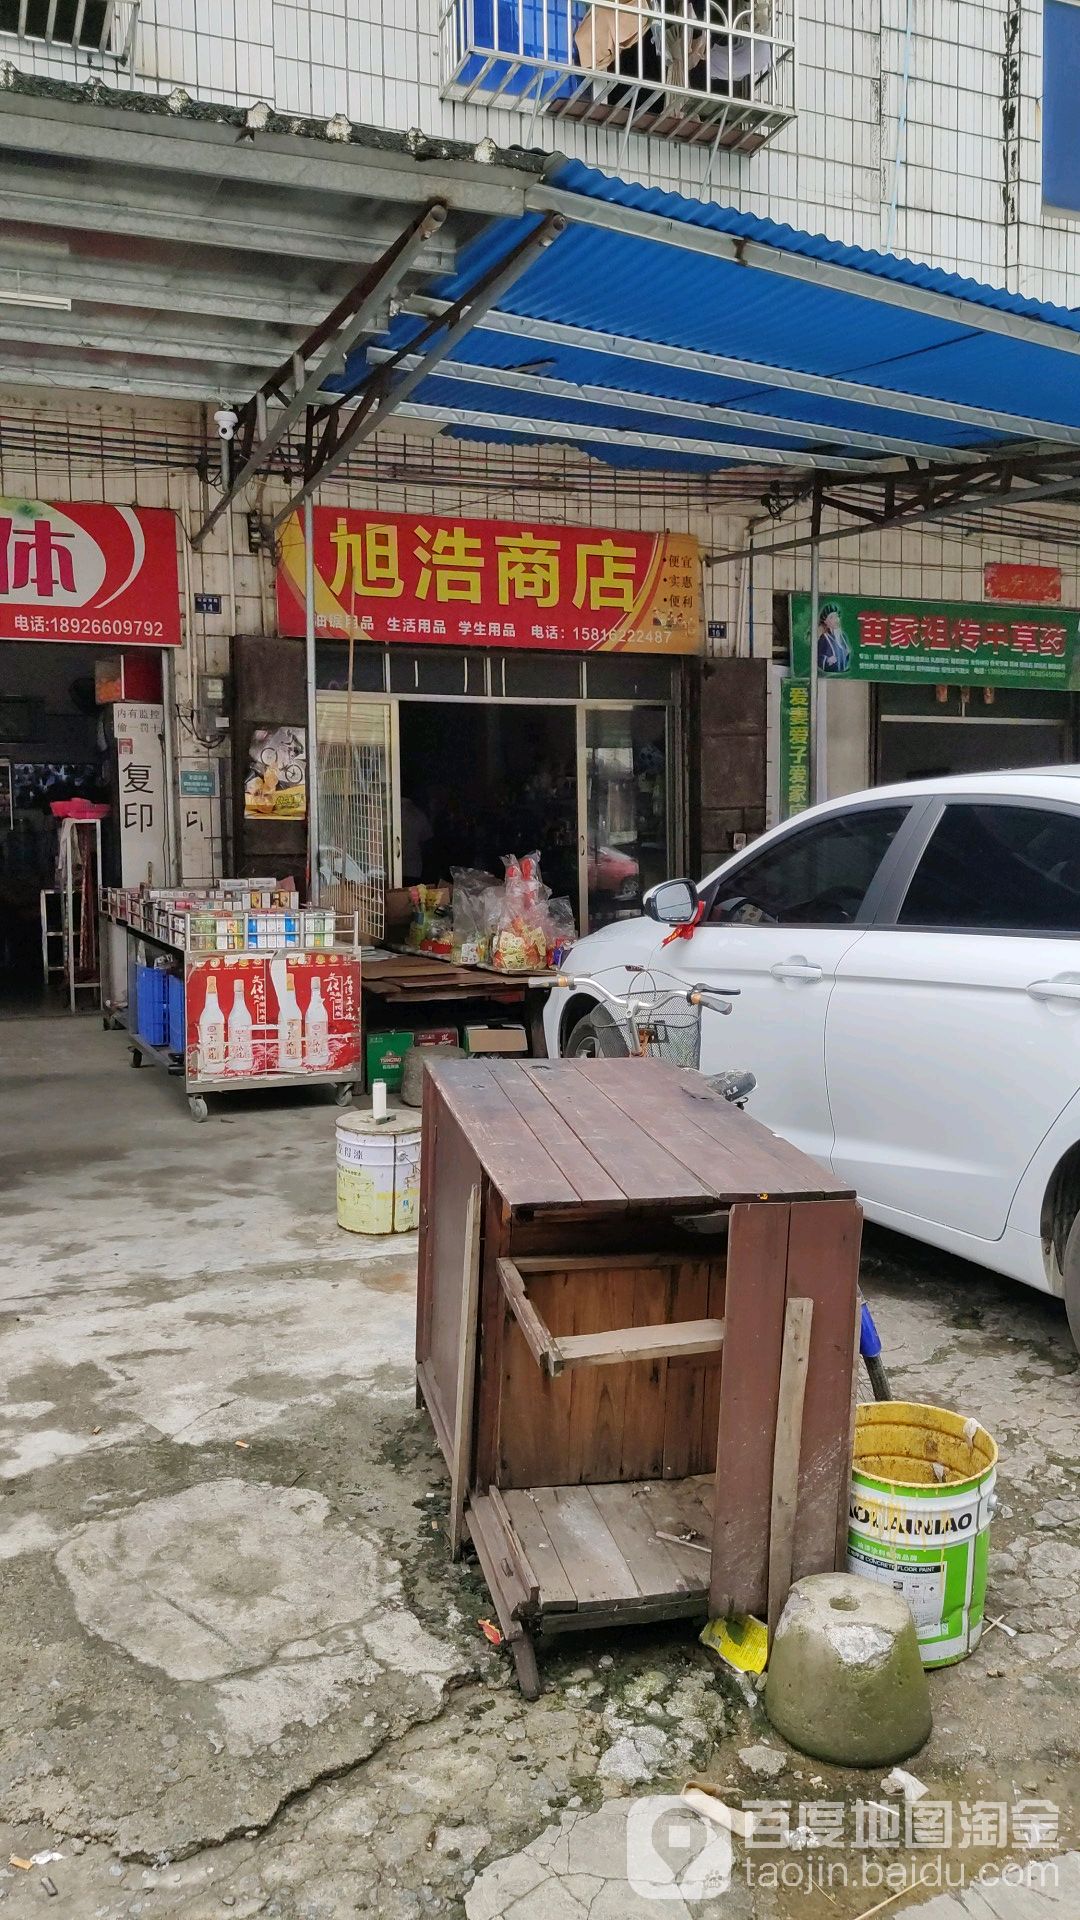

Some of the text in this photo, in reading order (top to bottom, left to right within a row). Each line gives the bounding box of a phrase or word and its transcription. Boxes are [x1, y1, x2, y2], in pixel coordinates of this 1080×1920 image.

[329, 517, 637, 613] 旭浩商店
[669, 555, 692, 568] 便宜
[670, 575, 693, 588] 实惠
[670, 595, 693, 608] 便利
[386, 617, 447, 634] 生活用品
[458, 620, 516, 637] 学生用品
[857, 610, 1067, 657] 苗家祖传中草药
[117, 708, 160, 719] 内有监控
[117, 722, 161, 733] 偷一罚十
[122, 762, 154, 833] 复印
